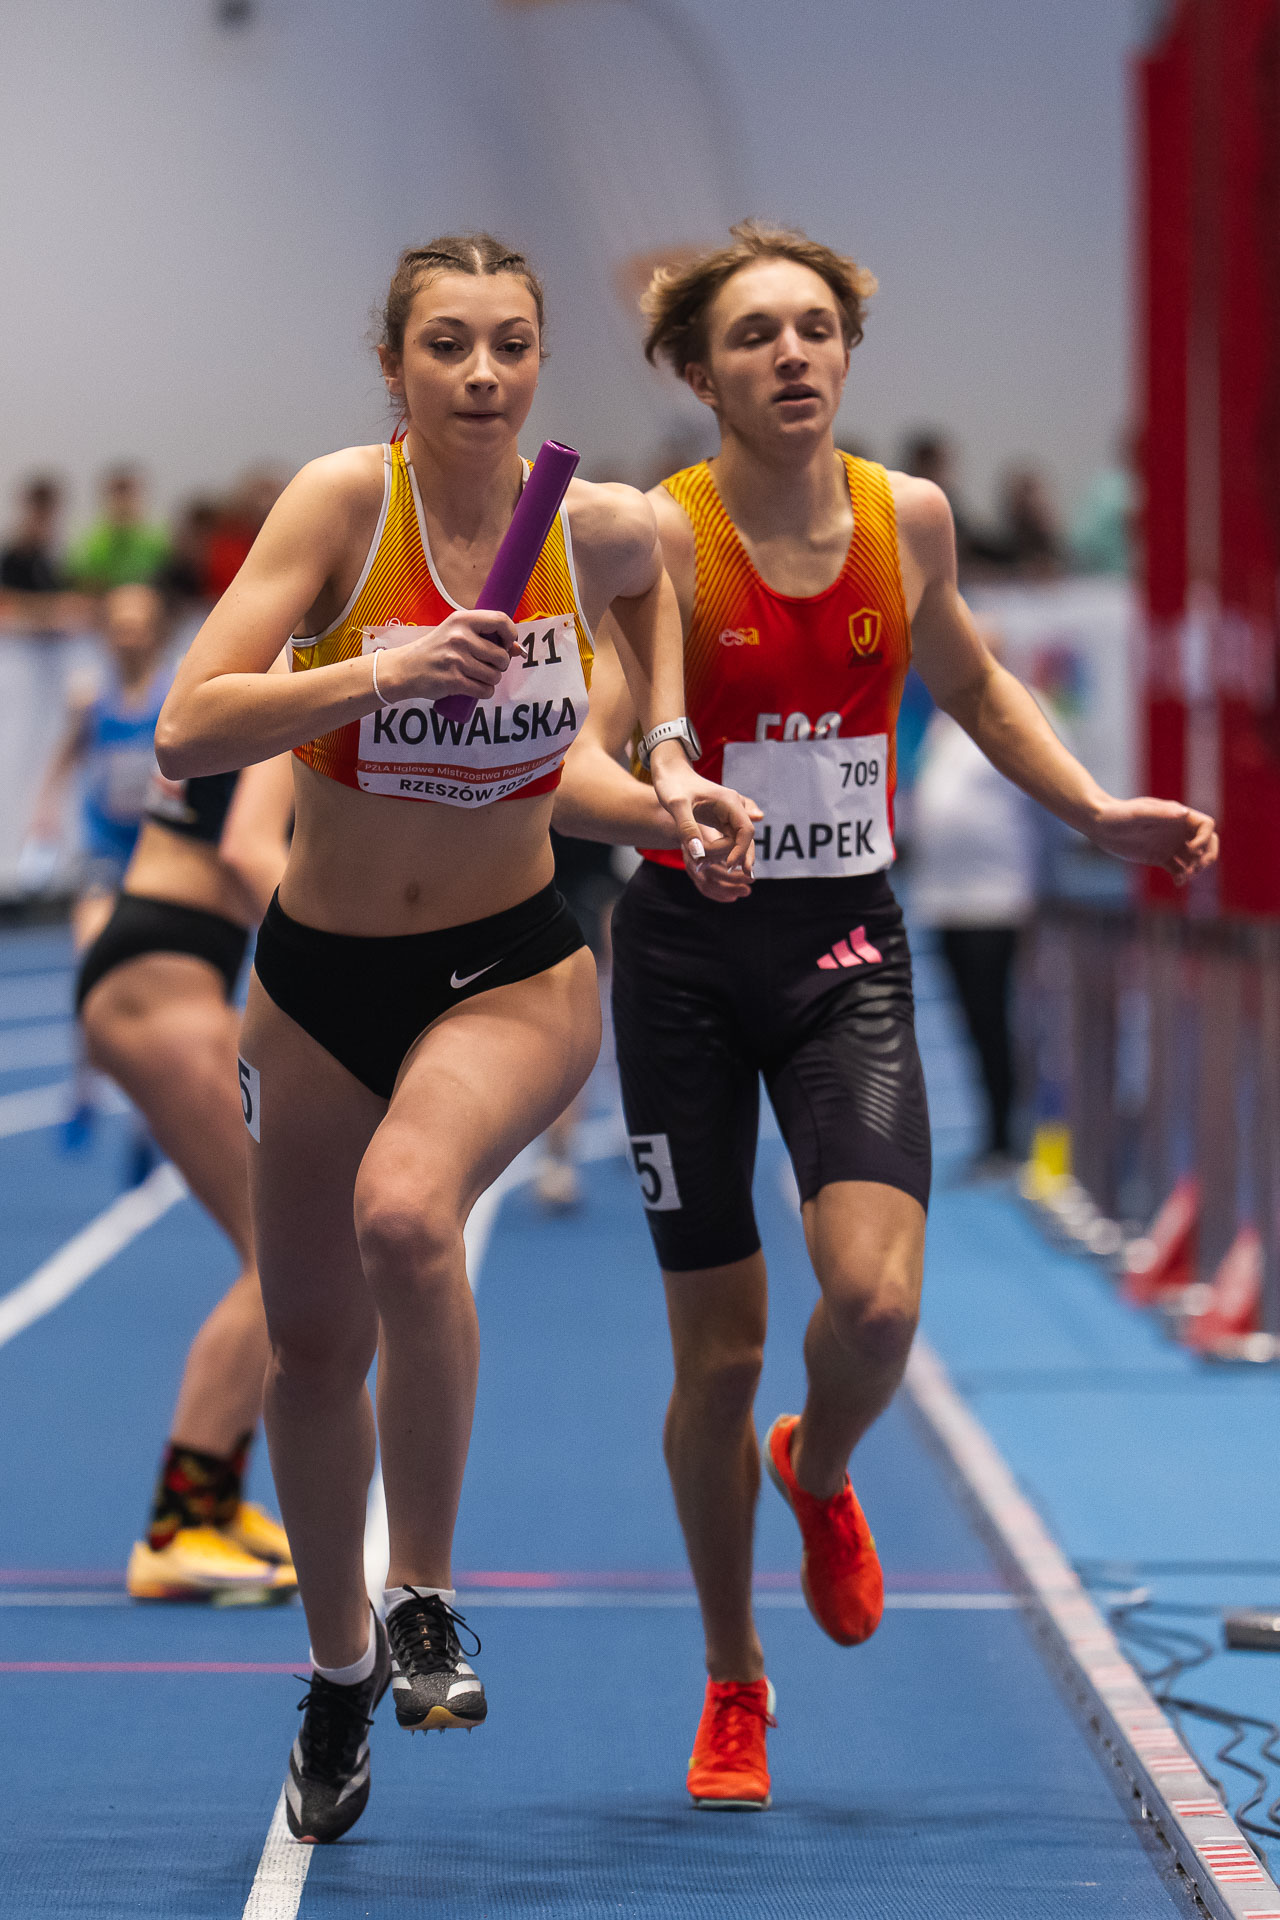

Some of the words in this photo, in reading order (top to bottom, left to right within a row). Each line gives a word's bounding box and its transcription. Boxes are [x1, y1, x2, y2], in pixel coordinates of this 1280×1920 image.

[719, 627, 760, 647] esa
[858, 618, 872, 646] J
[373, 697, 577, 746] KOWALSKA
[364, 763, 391, 772] PZLA
[437, 767, 501, 782] Mistrzostwa
[502, 763, 531, 777] Polski
[839, 760, 879, 789] 709
[400, 779, 493, 802] RZESZÓW
[238, 1056, 252, 1125] 5
[631, 1143, 662, 1204] 5
